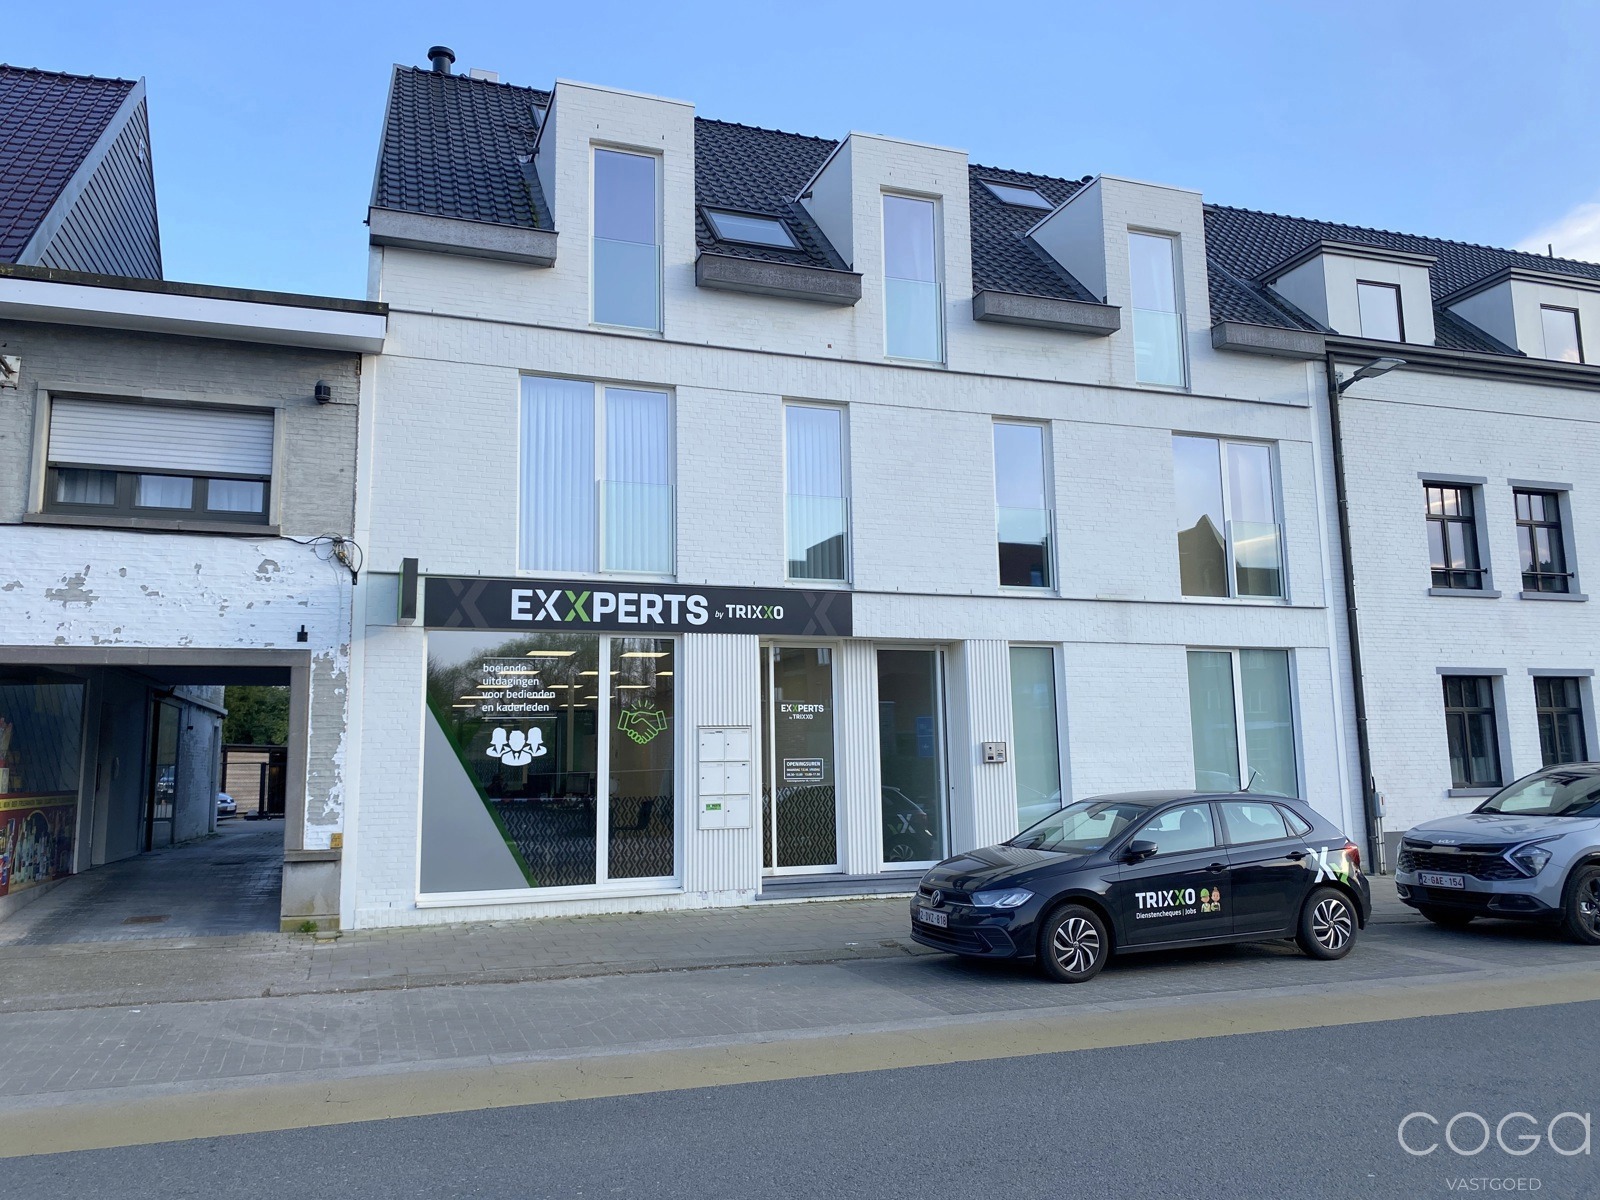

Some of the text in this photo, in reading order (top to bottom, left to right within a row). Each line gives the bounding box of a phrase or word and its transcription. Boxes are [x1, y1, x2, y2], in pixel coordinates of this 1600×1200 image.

[511, 588, 784, 625] EXXPERTS by TRIXXO
[482, 663, 527, 673] boeiende
[482, 676, 540, 688] uitdagingen
[482, 689, 556, 699] voor bedienden
[481, 702, 550, 712] en kaderleden
[781, 704, 825, 713] EXXPERTS
[1135, 888, 1196, 909] TRIXXO
[1135, 910, 1182, 919] Dienstencheques
